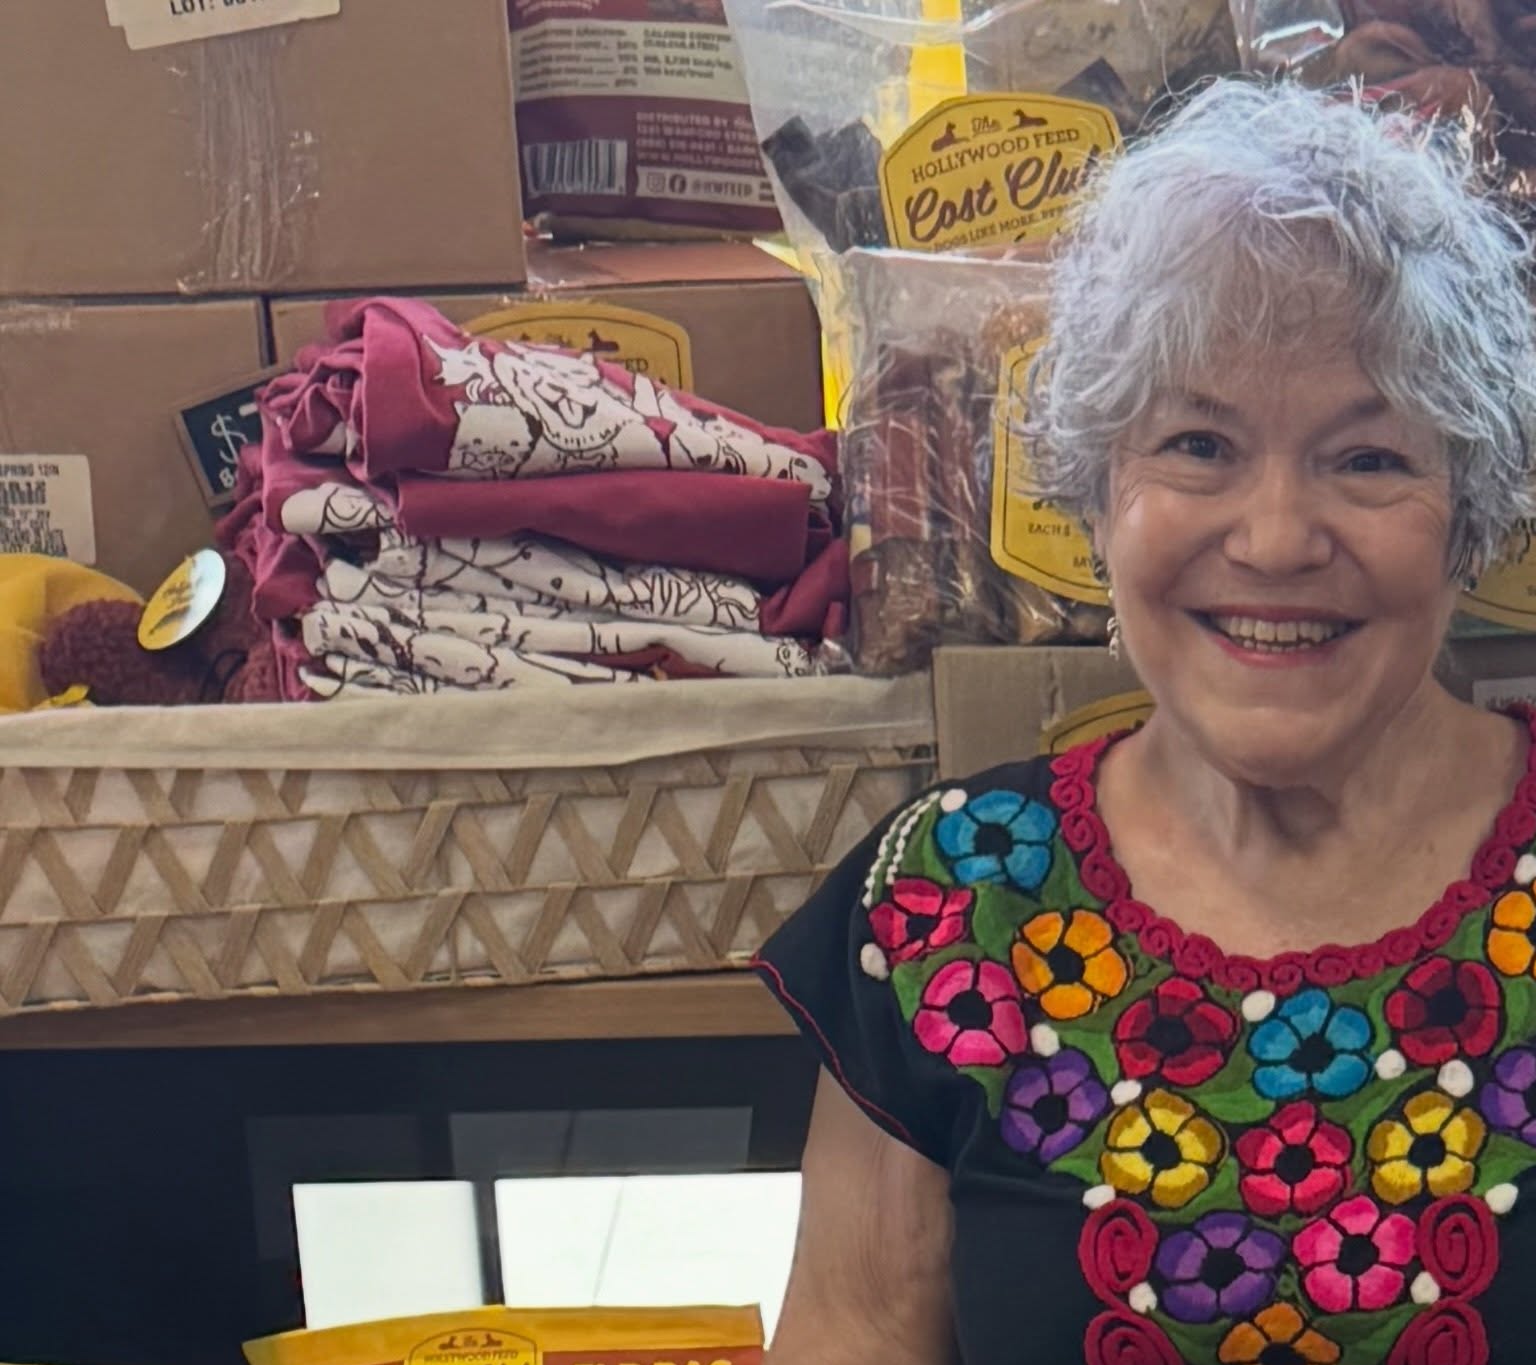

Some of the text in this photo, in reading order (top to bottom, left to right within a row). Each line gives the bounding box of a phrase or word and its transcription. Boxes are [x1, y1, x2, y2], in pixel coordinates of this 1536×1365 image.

[911, 128, 1080, 184] HOLLYWOOD FEED
[905, 178, 998, 243] Cost
